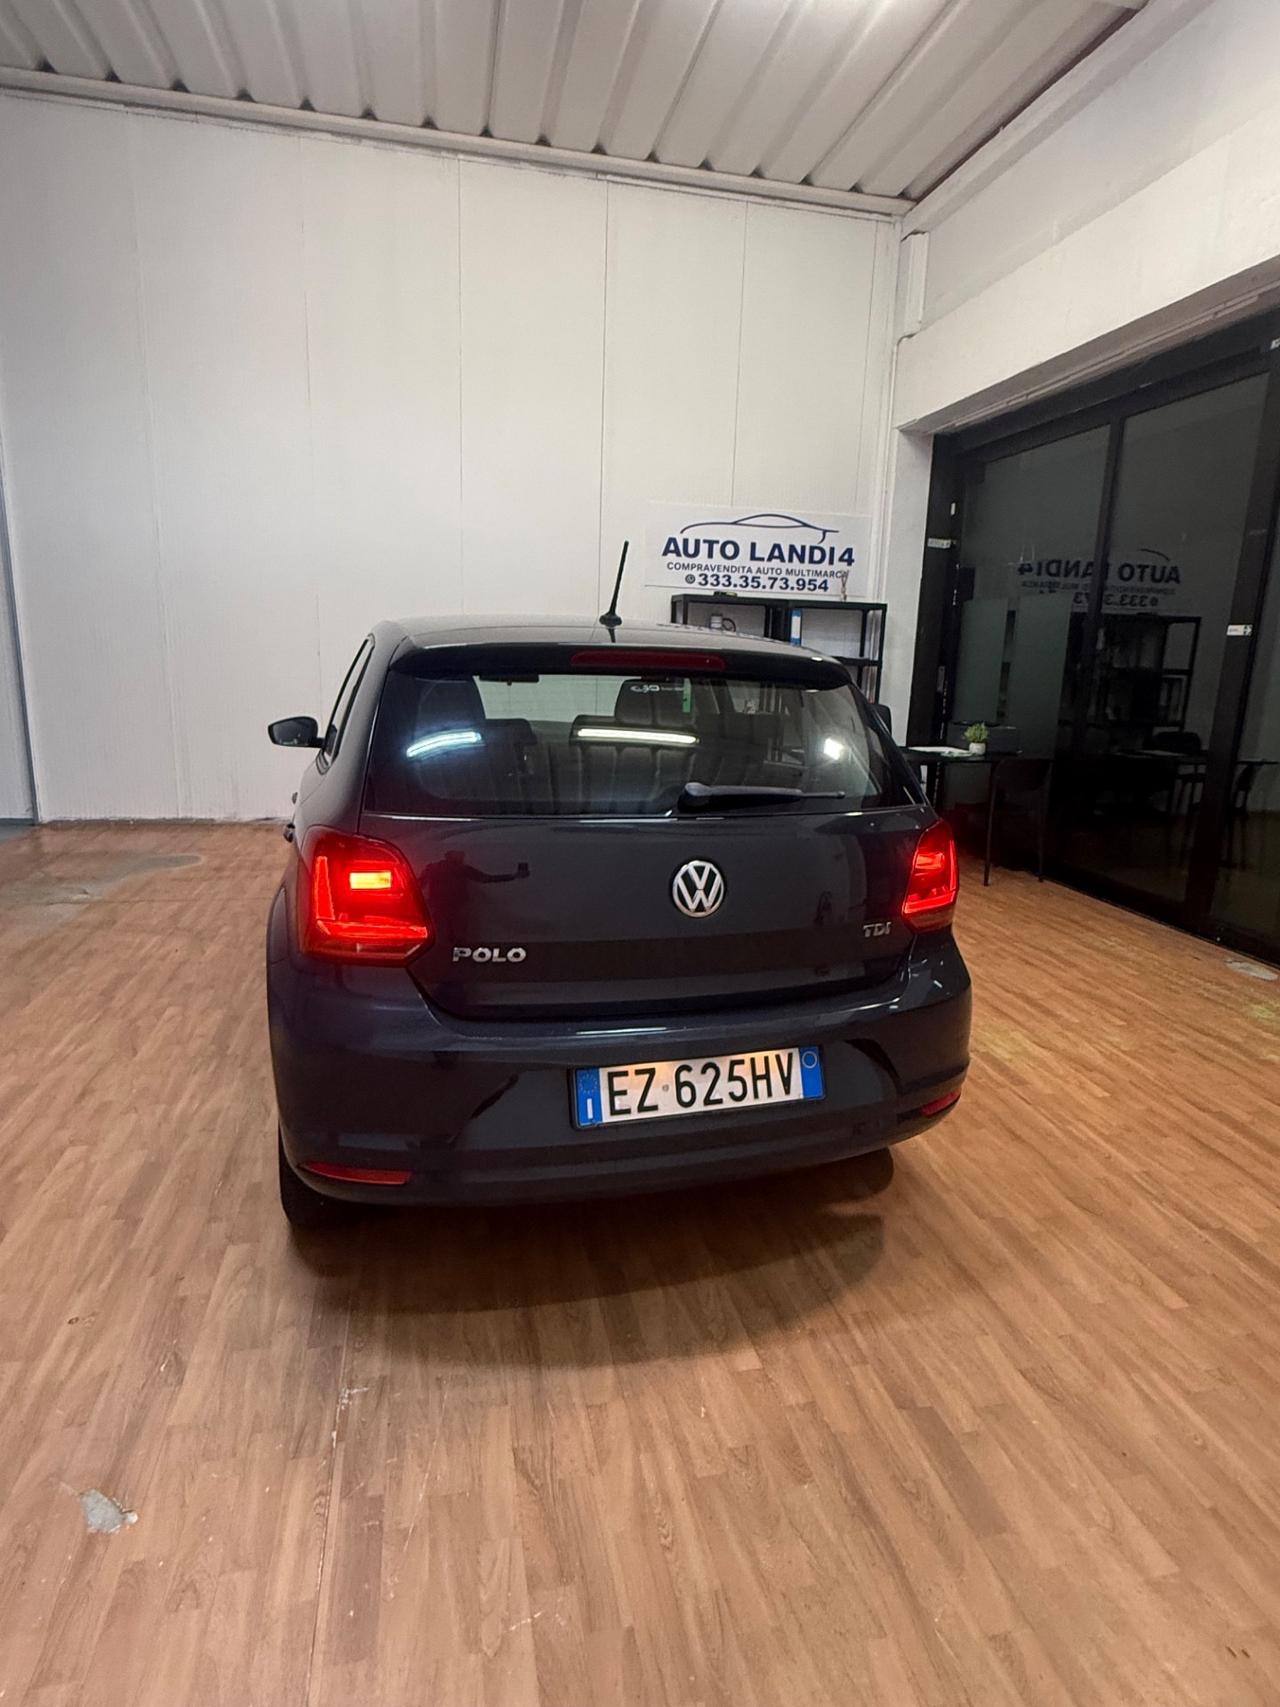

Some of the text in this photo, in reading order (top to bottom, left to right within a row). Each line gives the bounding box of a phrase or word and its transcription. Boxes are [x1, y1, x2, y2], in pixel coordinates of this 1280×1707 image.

[661, 536, 741, 560] AUTO
[666, 561, 754, 575] COMPRAVENDITA
[755, 566, 783, 576] AUTO
[697, 573, 829, 592] 333.35.73.954
[863, 921, 892, 938] TDI
[452, 946, 527, 963] POLO
[607, 1067, 659, 1117] EZ
[674, 1052, 794, 1109] 625HV
